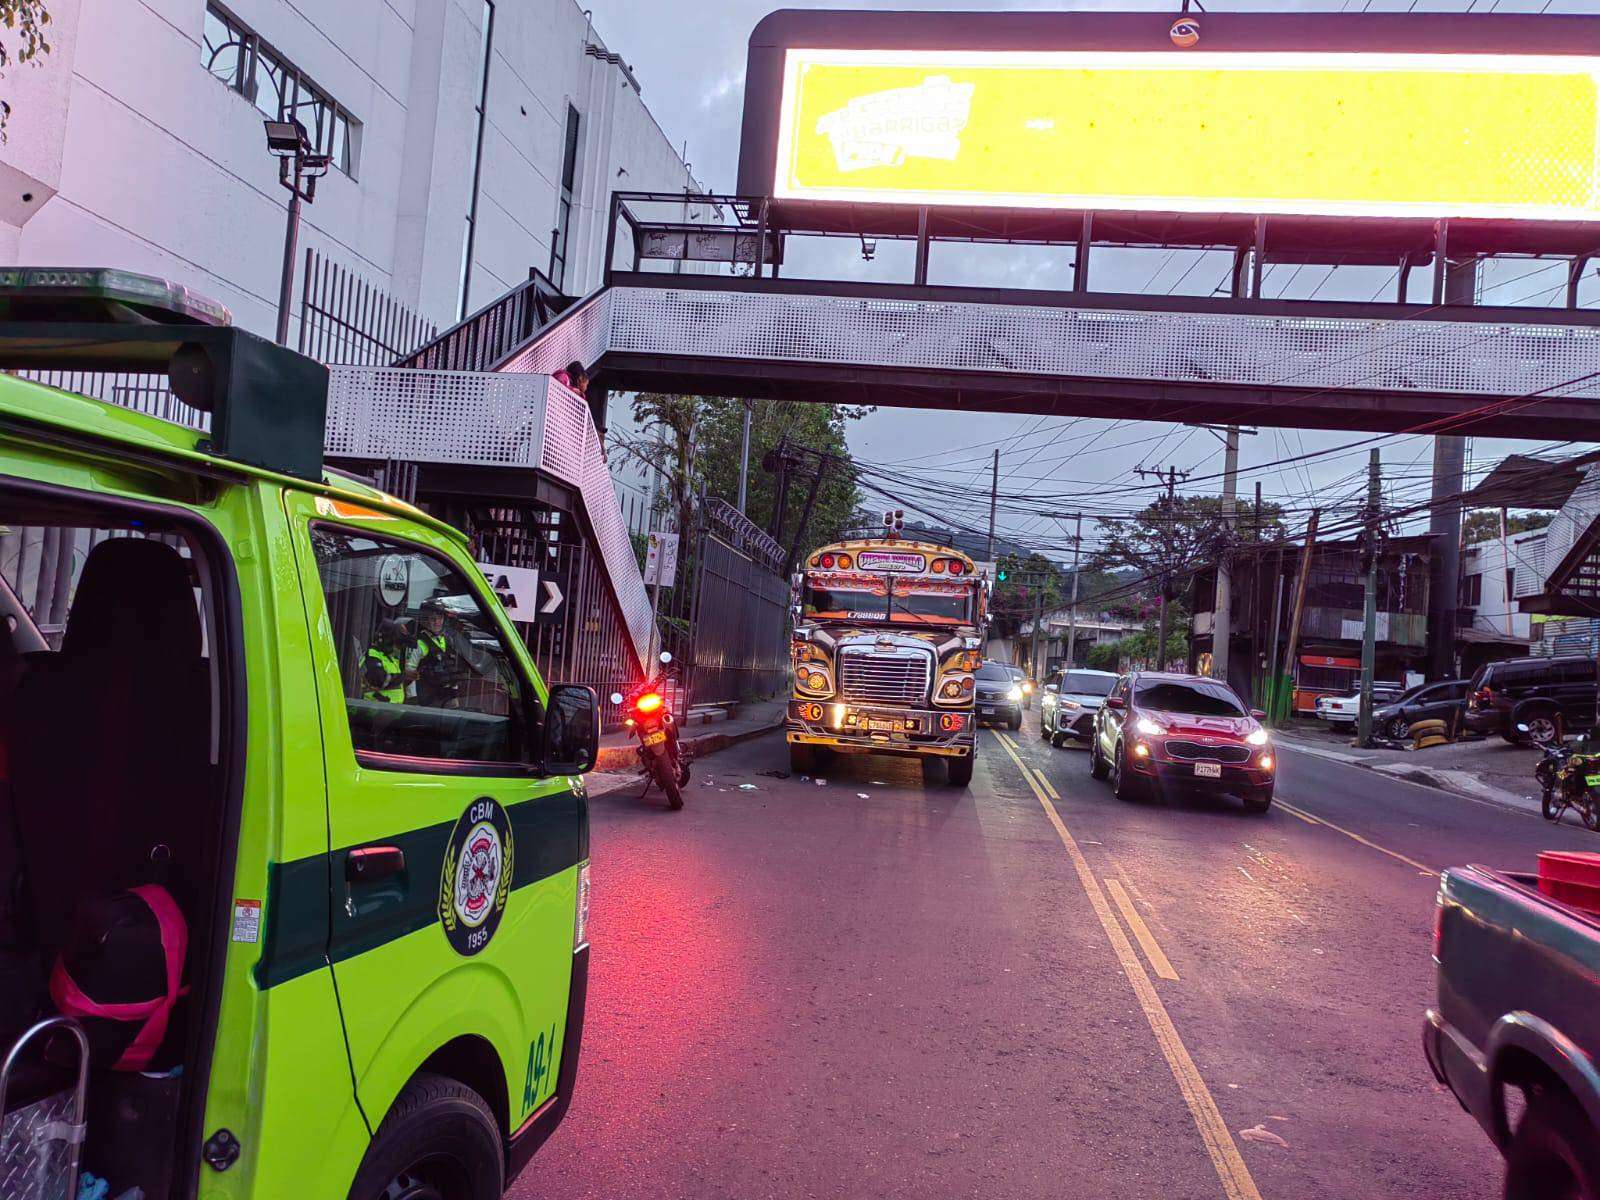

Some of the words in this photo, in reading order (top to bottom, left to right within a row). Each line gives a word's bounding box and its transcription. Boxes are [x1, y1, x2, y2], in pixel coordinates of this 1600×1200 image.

[470, 801, 493, 824] CBM
[467, 928, 488, 950] 1955
[521, 1022, 555, 1118] A9-1
